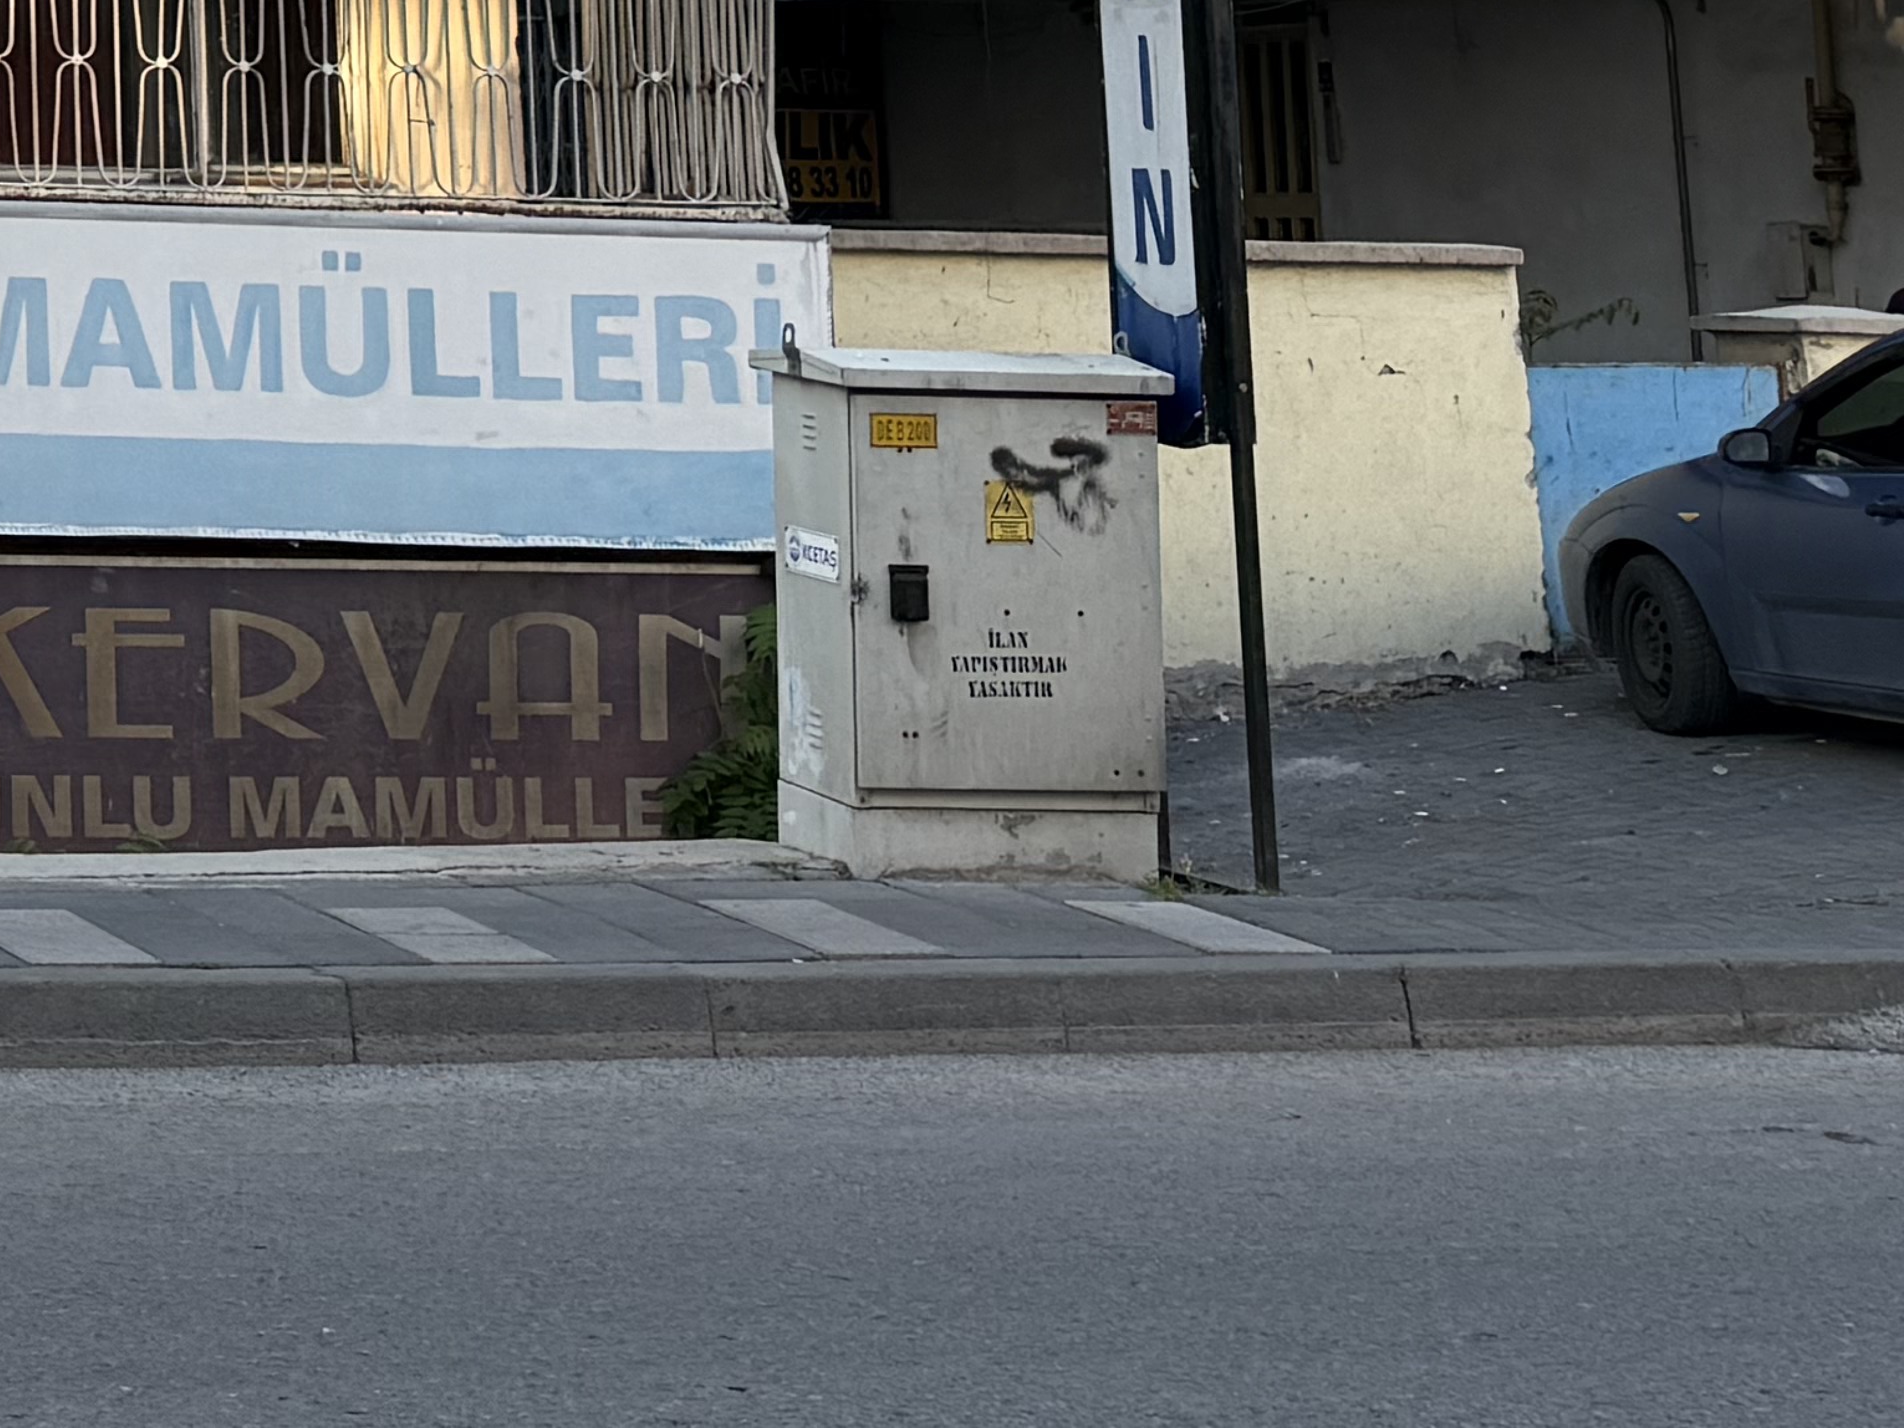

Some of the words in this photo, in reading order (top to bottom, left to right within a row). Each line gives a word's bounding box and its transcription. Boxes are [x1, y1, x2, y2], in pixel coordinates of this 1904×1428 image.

[810, 166, 839, 198] 33
[847, 166, 873, 198] 10
[988, 627, 1029, 649] İLAN
[968, 679, 1053, 698] YASAKTIR
[229, 757, 672, 840] MAMÜLLE
